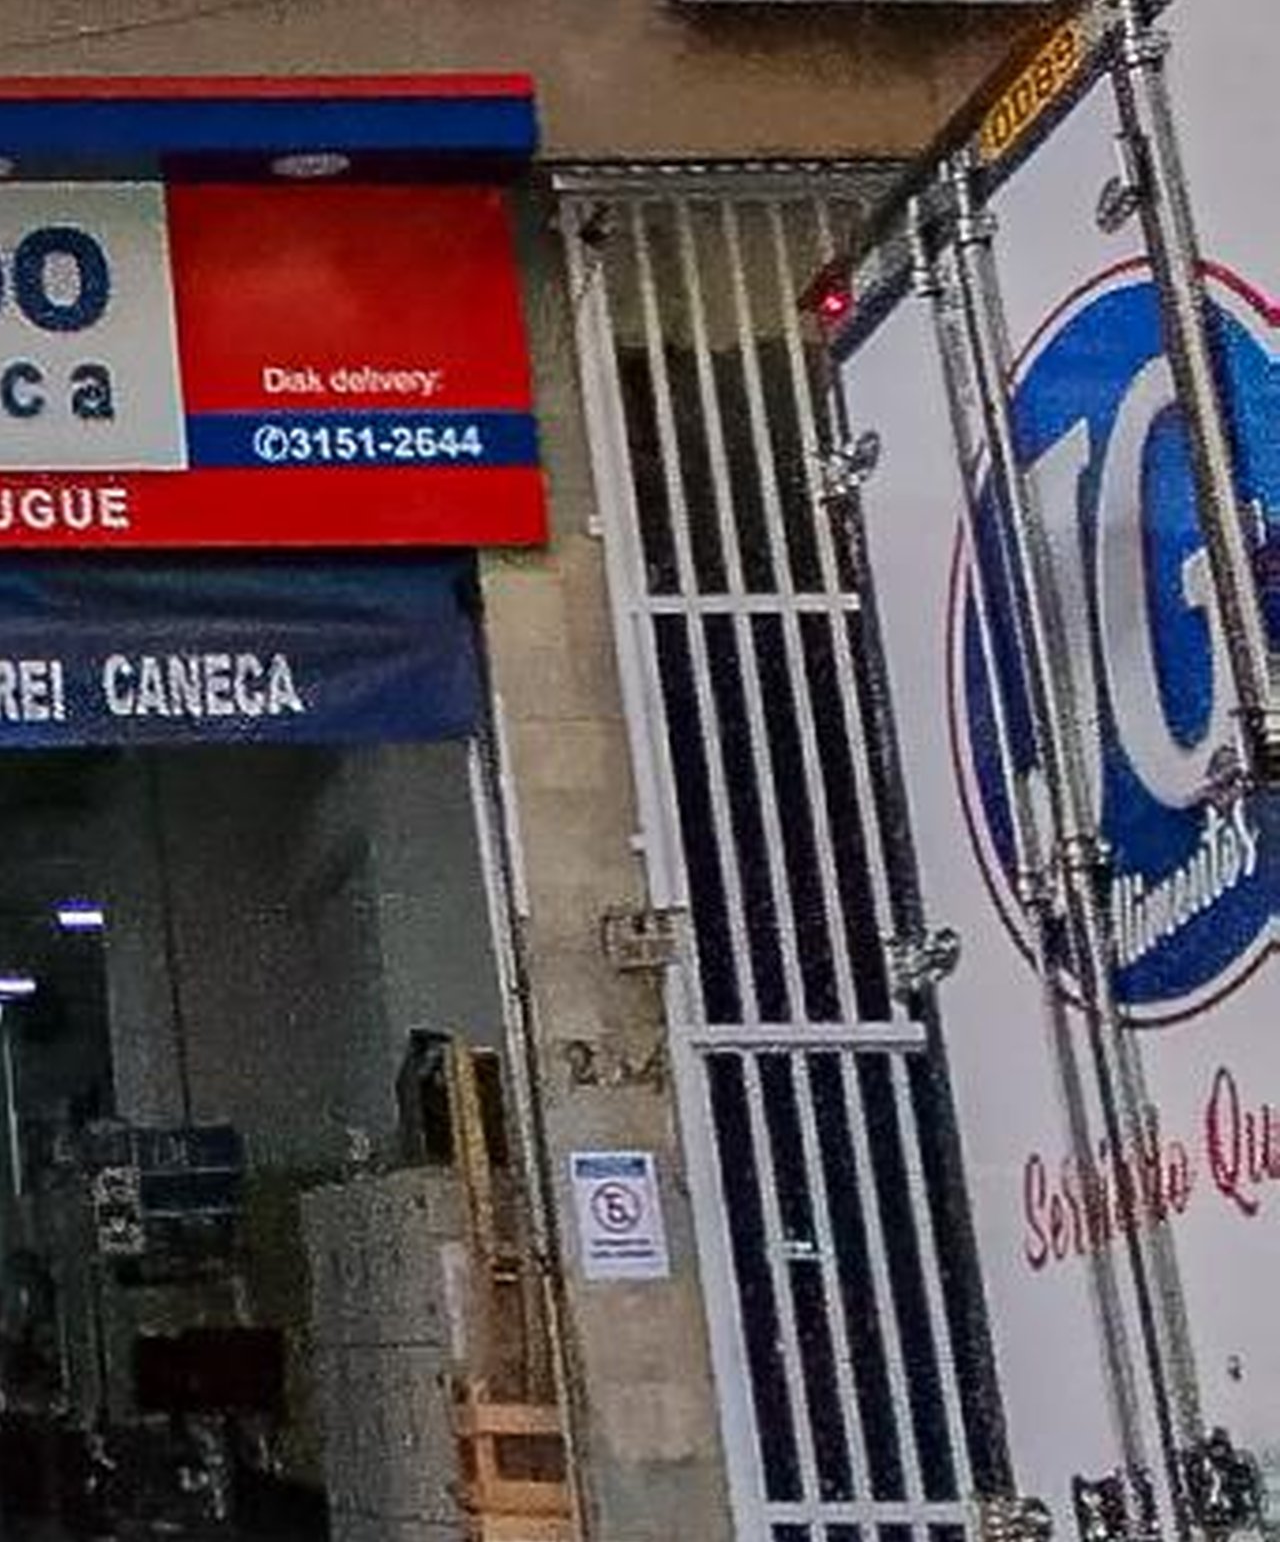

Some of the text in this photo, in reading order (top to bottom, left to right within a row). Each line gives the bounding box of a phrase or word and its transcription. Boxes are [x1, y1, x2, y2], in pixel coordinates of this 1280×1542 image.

[263, 366, 441, 396] Disk delivery:
[289, 426, 482, 460] 3151-2644
[102, 653, 305, 718] CANECA
